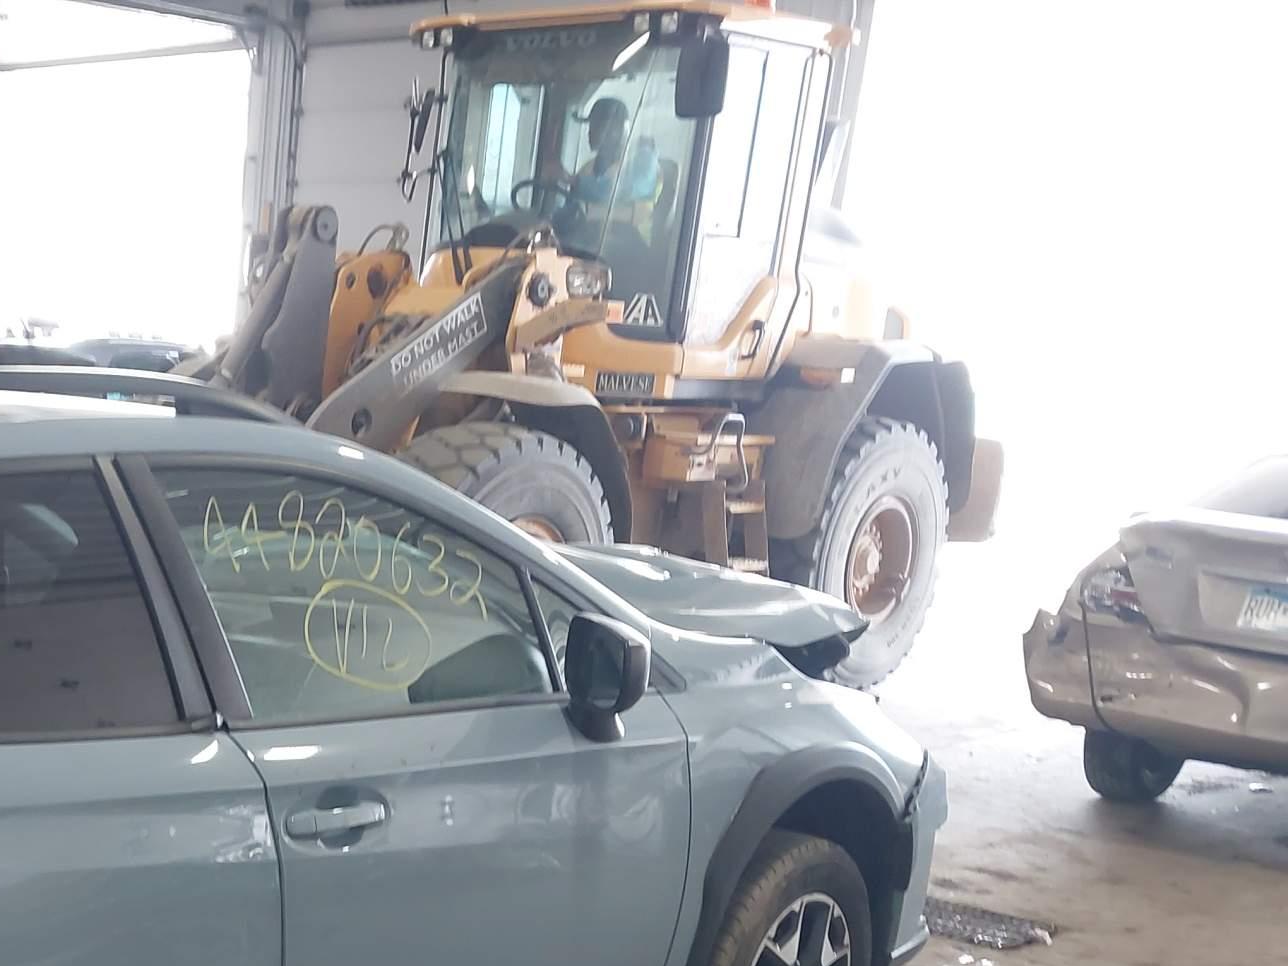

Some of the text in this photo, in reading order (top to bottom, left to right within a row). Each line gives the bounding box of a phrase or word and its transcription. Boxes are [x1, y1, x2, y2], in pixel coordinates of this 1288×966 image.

[392, 295, 479, 376] DO NOT WALK
